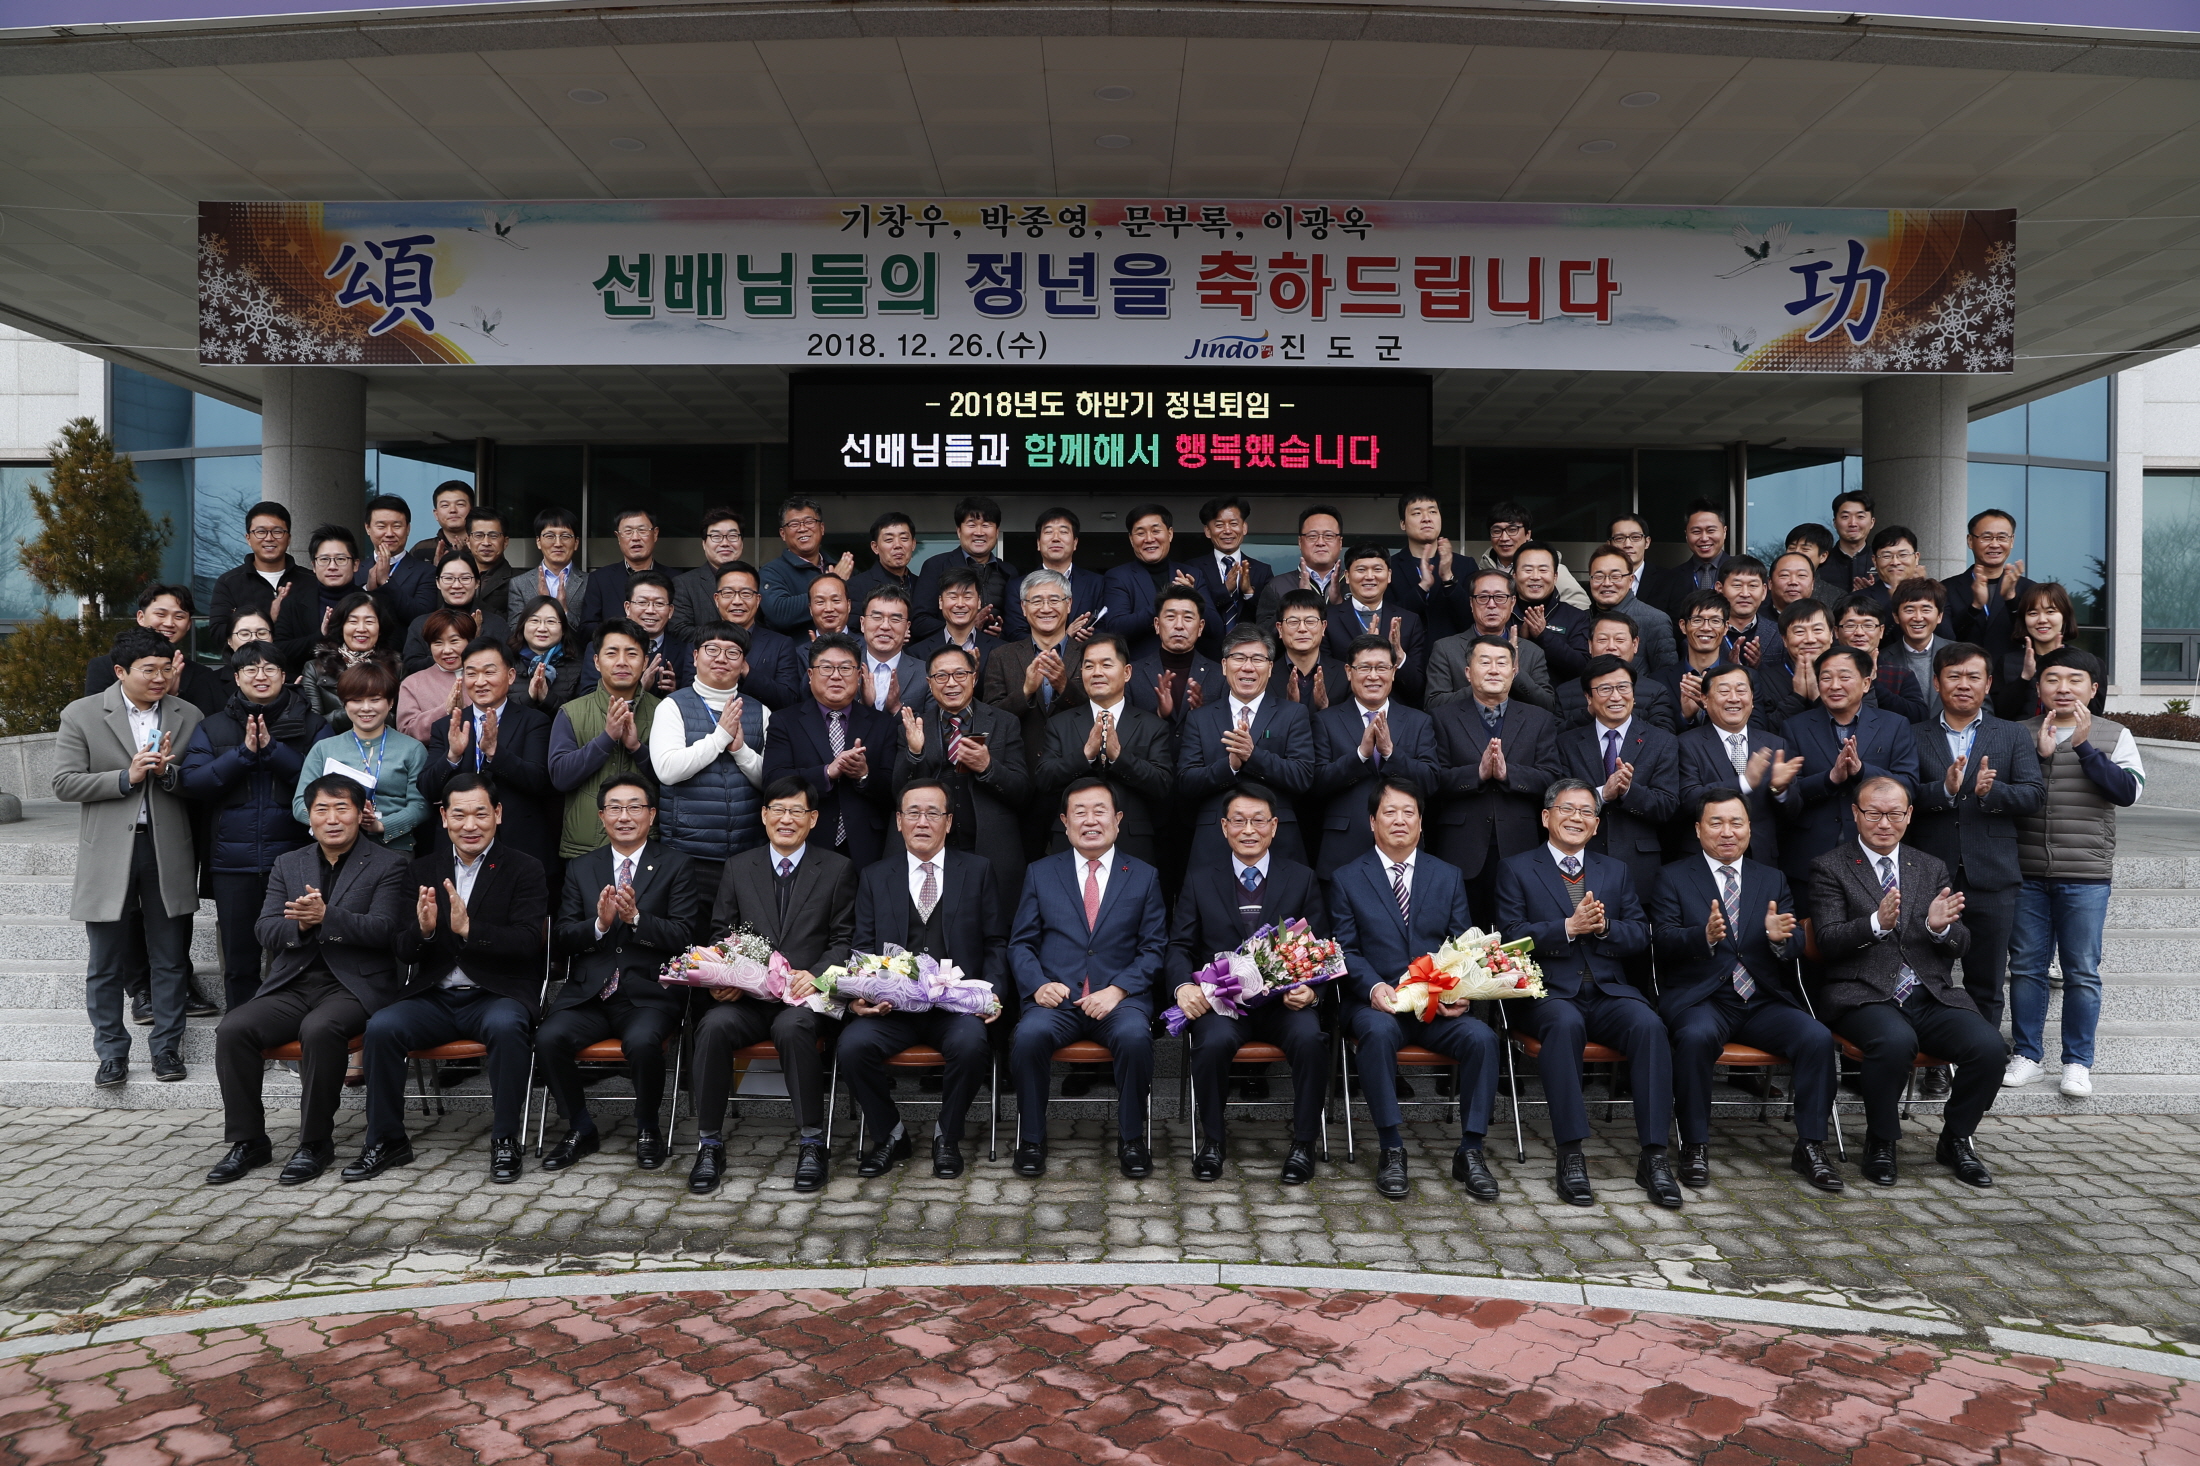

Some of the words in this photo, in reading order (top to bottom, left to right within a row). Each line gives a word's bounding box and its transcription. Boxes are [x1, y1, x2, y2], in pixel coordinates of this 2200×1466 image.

[840, 203, 962, 240] 기창우,
[980, 204, 1103, 241] 박종영,
[1120, 205, 1244, 242] 문부록,
[1263, 205, 1373, 241] 이광옥
[327, 234, 437, 335] 頌
[593, 251, 939, 318] 선배님들의
[964, 251, 1172, 317] 정년을
[1196, 250, 1619, 321] 축하드립니다
[1784, 239, 1886, 342] 功
[807, 333, 885, 358] 2018.
[897, 333, 936, 358] 12.
[948, 330, 1048, 360] 26.(수)
[1184, 338, 1259, 359] Jindo
[949, 390, 1065, 418] 2018년도
[1075, 390, 1153, 419] 하반기
[1165, 390, 1270, 420] 정년퇴임
[840, 433, 1010, 468] 선배님들과
[1025, 433, 1159, 468] 함께해서
[1175, 433, 1381, 469] 행복했습니다
